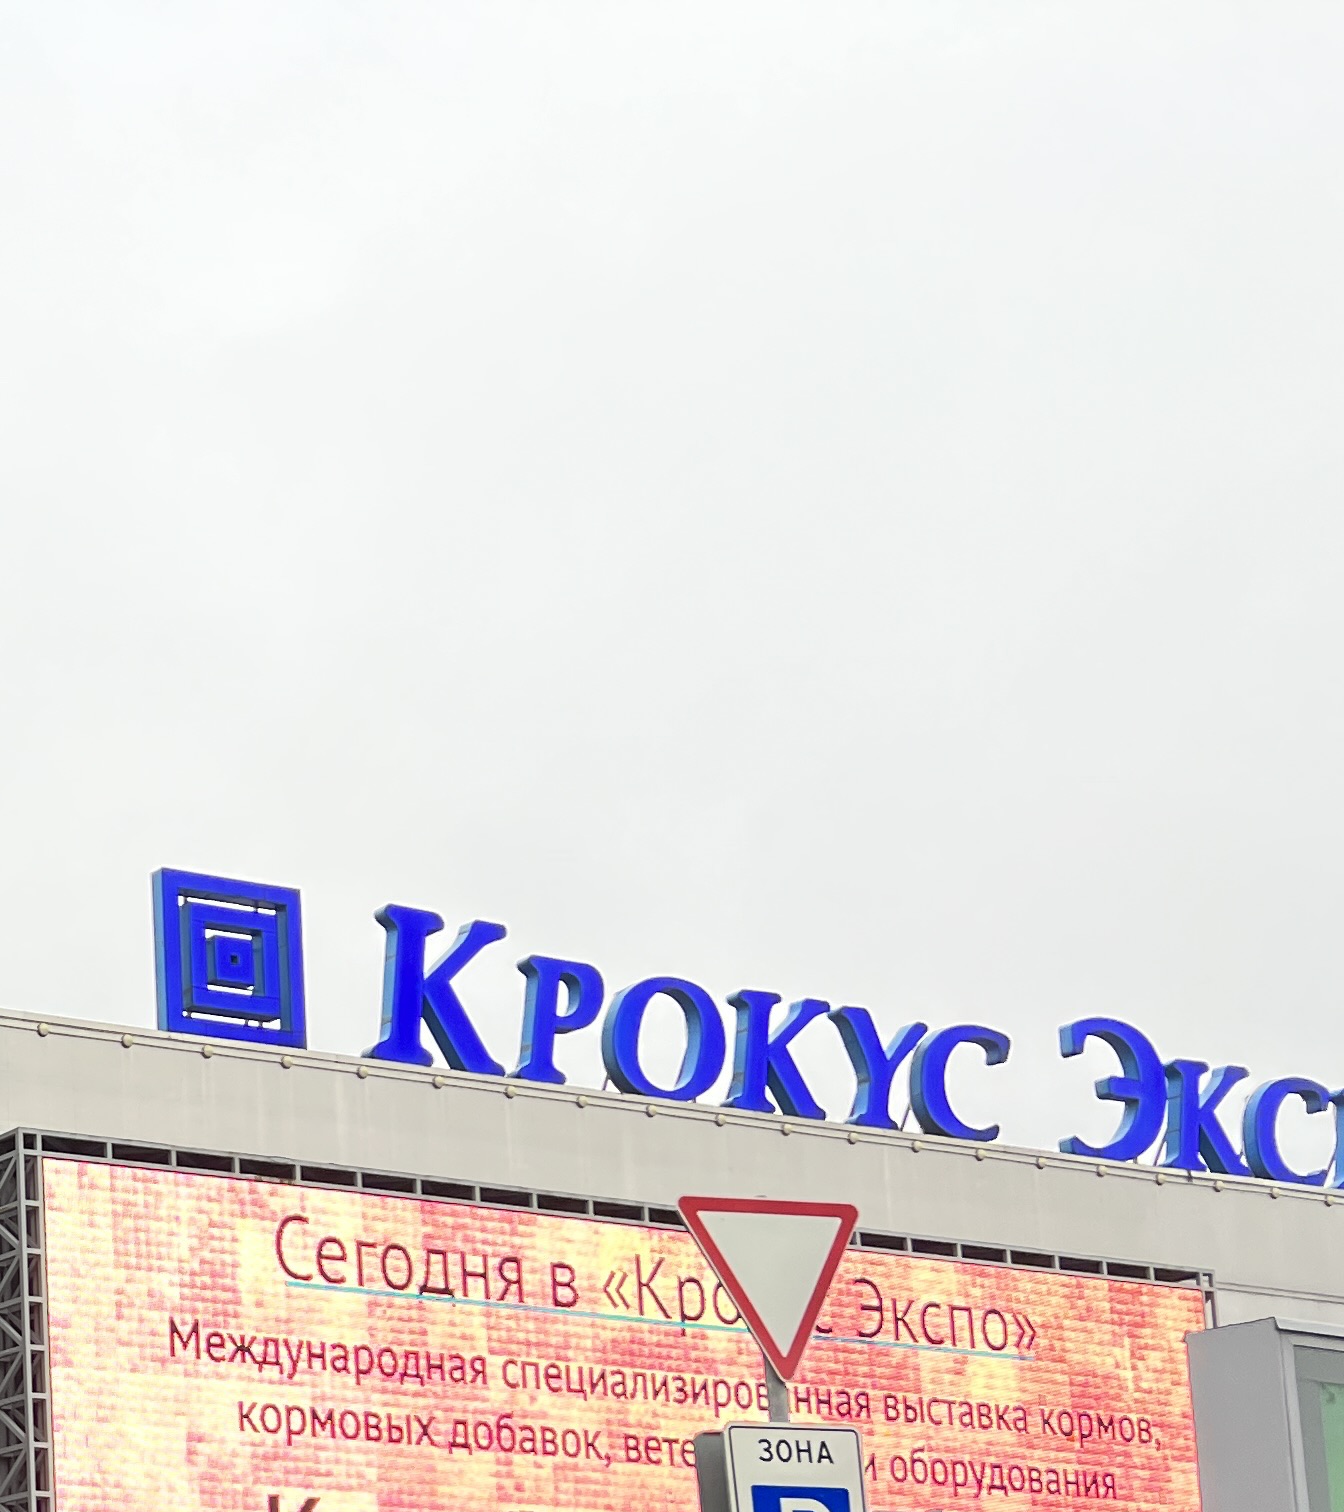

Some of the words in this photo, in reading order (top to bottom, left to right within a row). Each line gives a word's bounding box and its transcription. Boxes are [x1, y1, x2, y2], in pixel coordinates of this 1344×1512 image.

[1059, 1016, 1344, 1189] ЭКС
[275, 1214, 524, 1304] Сегодня
[550, 1261, 579, 1309] в
[602, 1252, 833, 1336] «Кро
[853, 1277, 1037, 1352] Экспо»
[168, 1317, 488, 1387] Международная
[502, 1357, 871, 1419] специализировнная
[884, 1392, 1029, 1432] выставка
[1041, 1407, 1163, 1451] кормов,
[237, 1401, 435, 1446] кормовых
[448, 1415, 612, 1467] добавок,
[889, 1452, 1117, 1500] оборудования
[757, 1439, 835, 1464] ЗОНА
